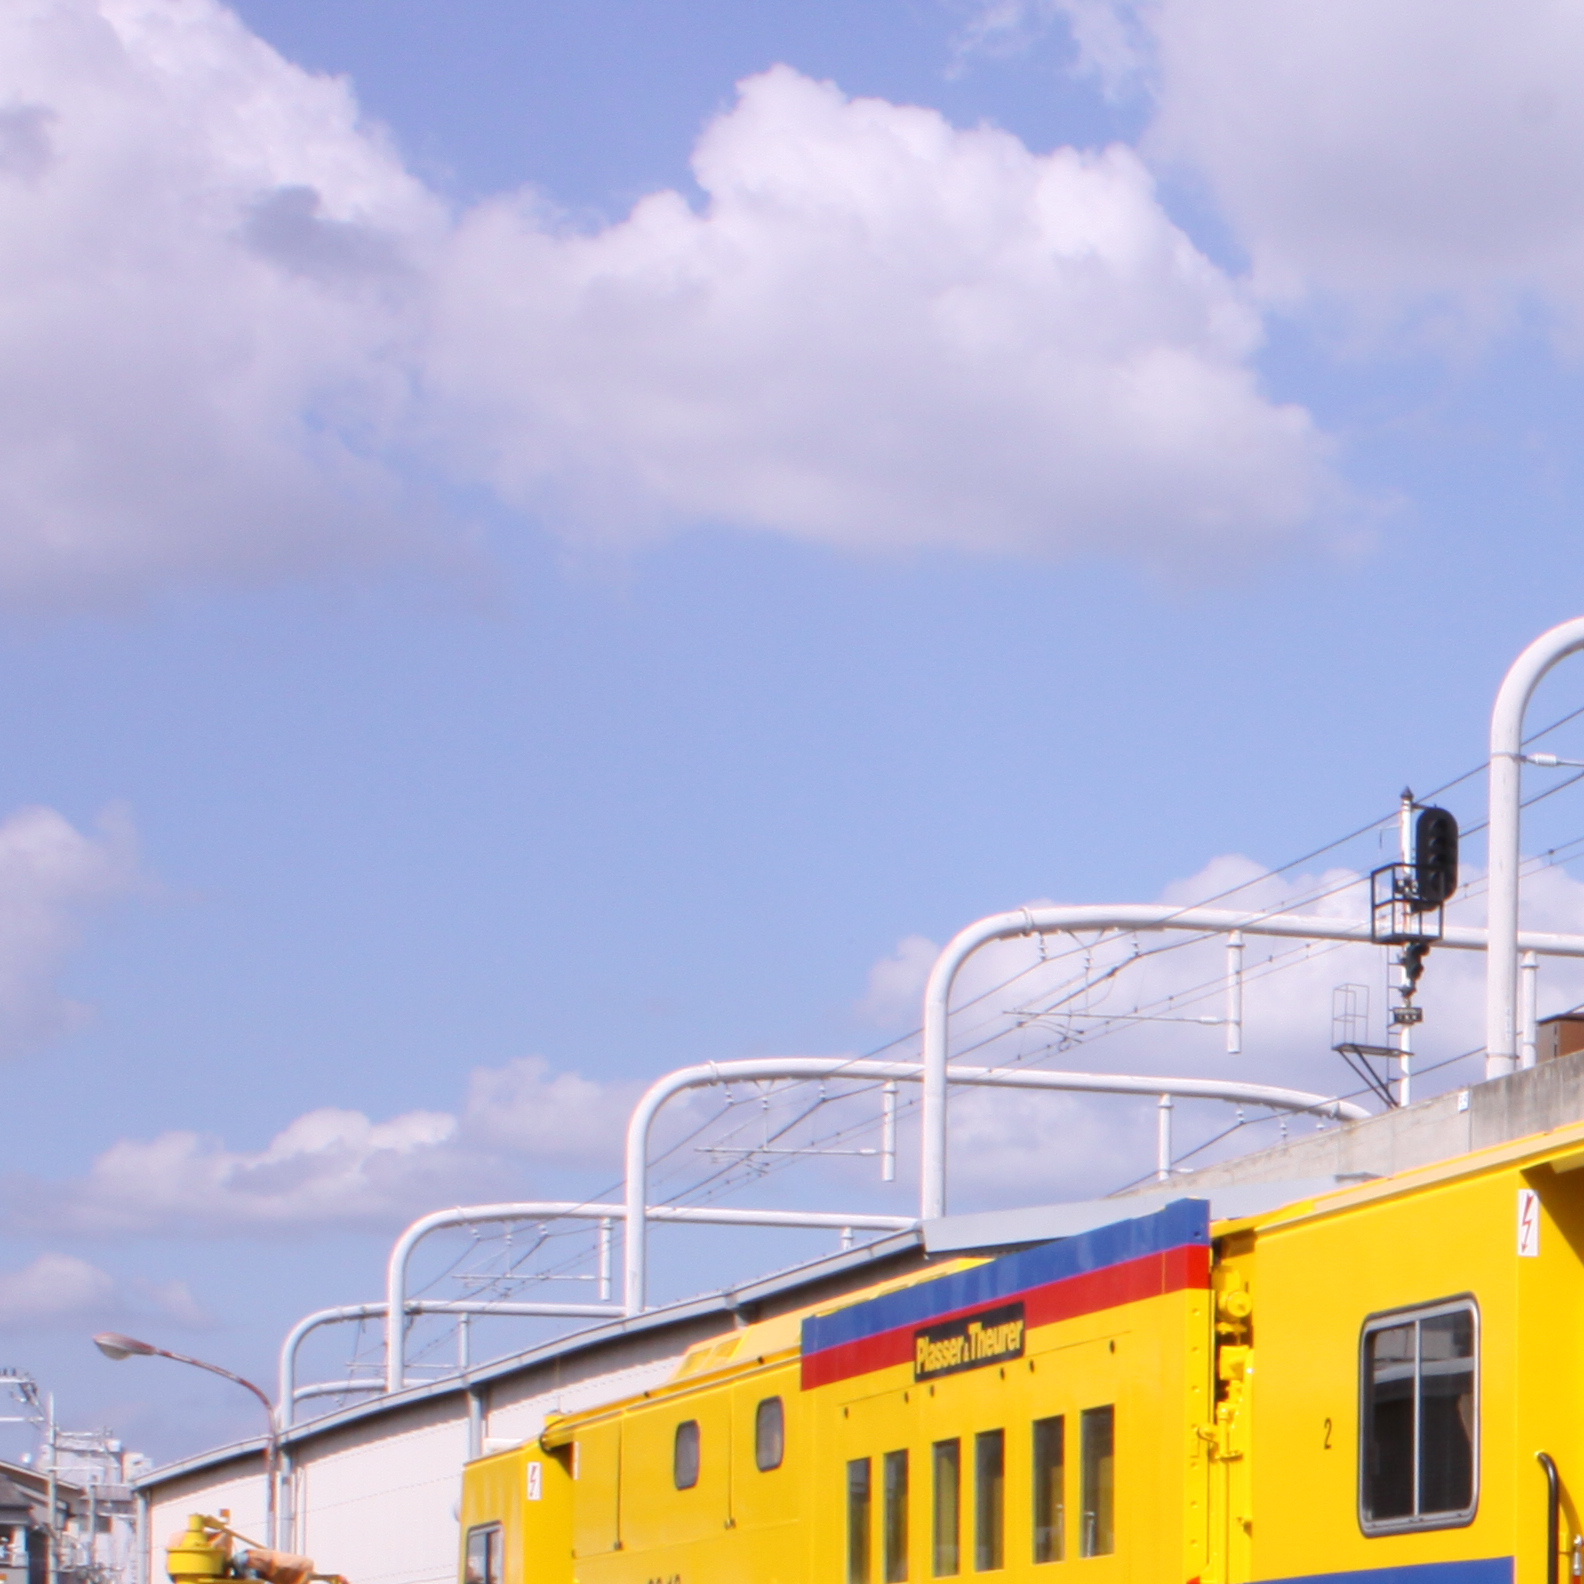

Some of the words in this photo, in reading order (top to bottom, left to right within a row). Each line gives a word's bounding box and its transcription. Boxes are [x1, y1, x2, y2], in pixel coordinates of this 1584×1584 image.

[916, 1336, 964, 1374] Plasser
[967, 1320, 1024, 1361] Theurer
[1324, 1417, 1332, 1450] 2
